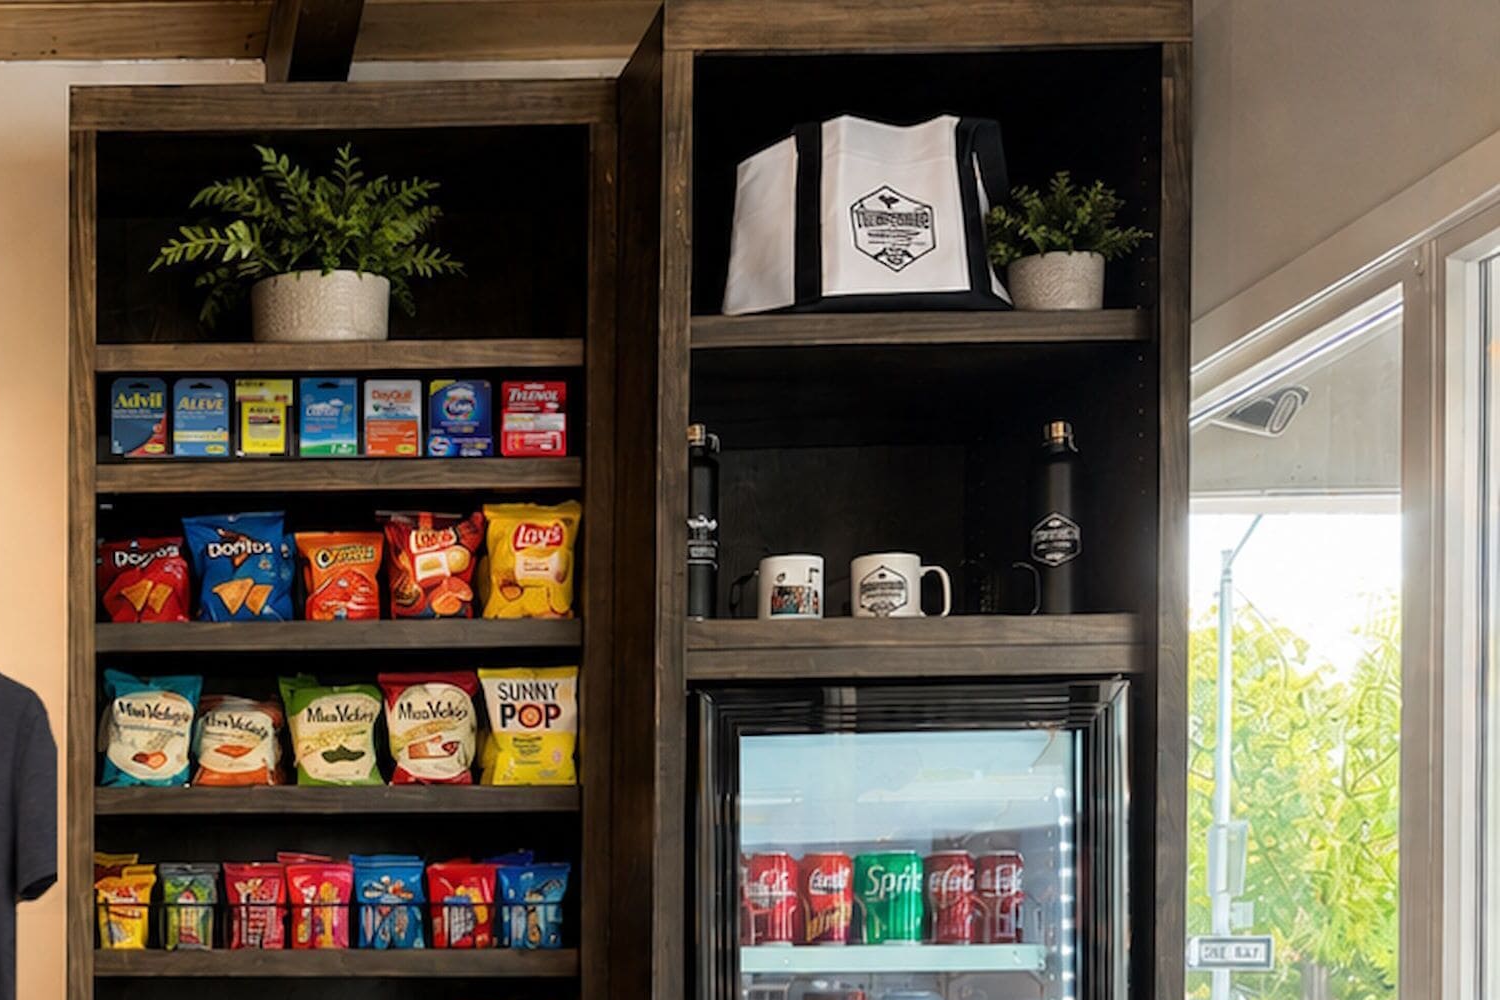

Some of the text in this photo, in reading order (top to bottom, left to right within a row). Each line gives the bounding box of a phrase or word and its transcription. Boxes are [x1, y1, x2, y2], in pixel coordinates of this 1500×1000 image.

[114, 392, 163, 409] Advil
[177, 396, 225, 411] ALEVE
[507, 387, 559, 402] TYLENOL
[515, 525, 561, 549] Lay's
[114, 545, 180, 568] Doos
[500, 704, 562, 728] POP
